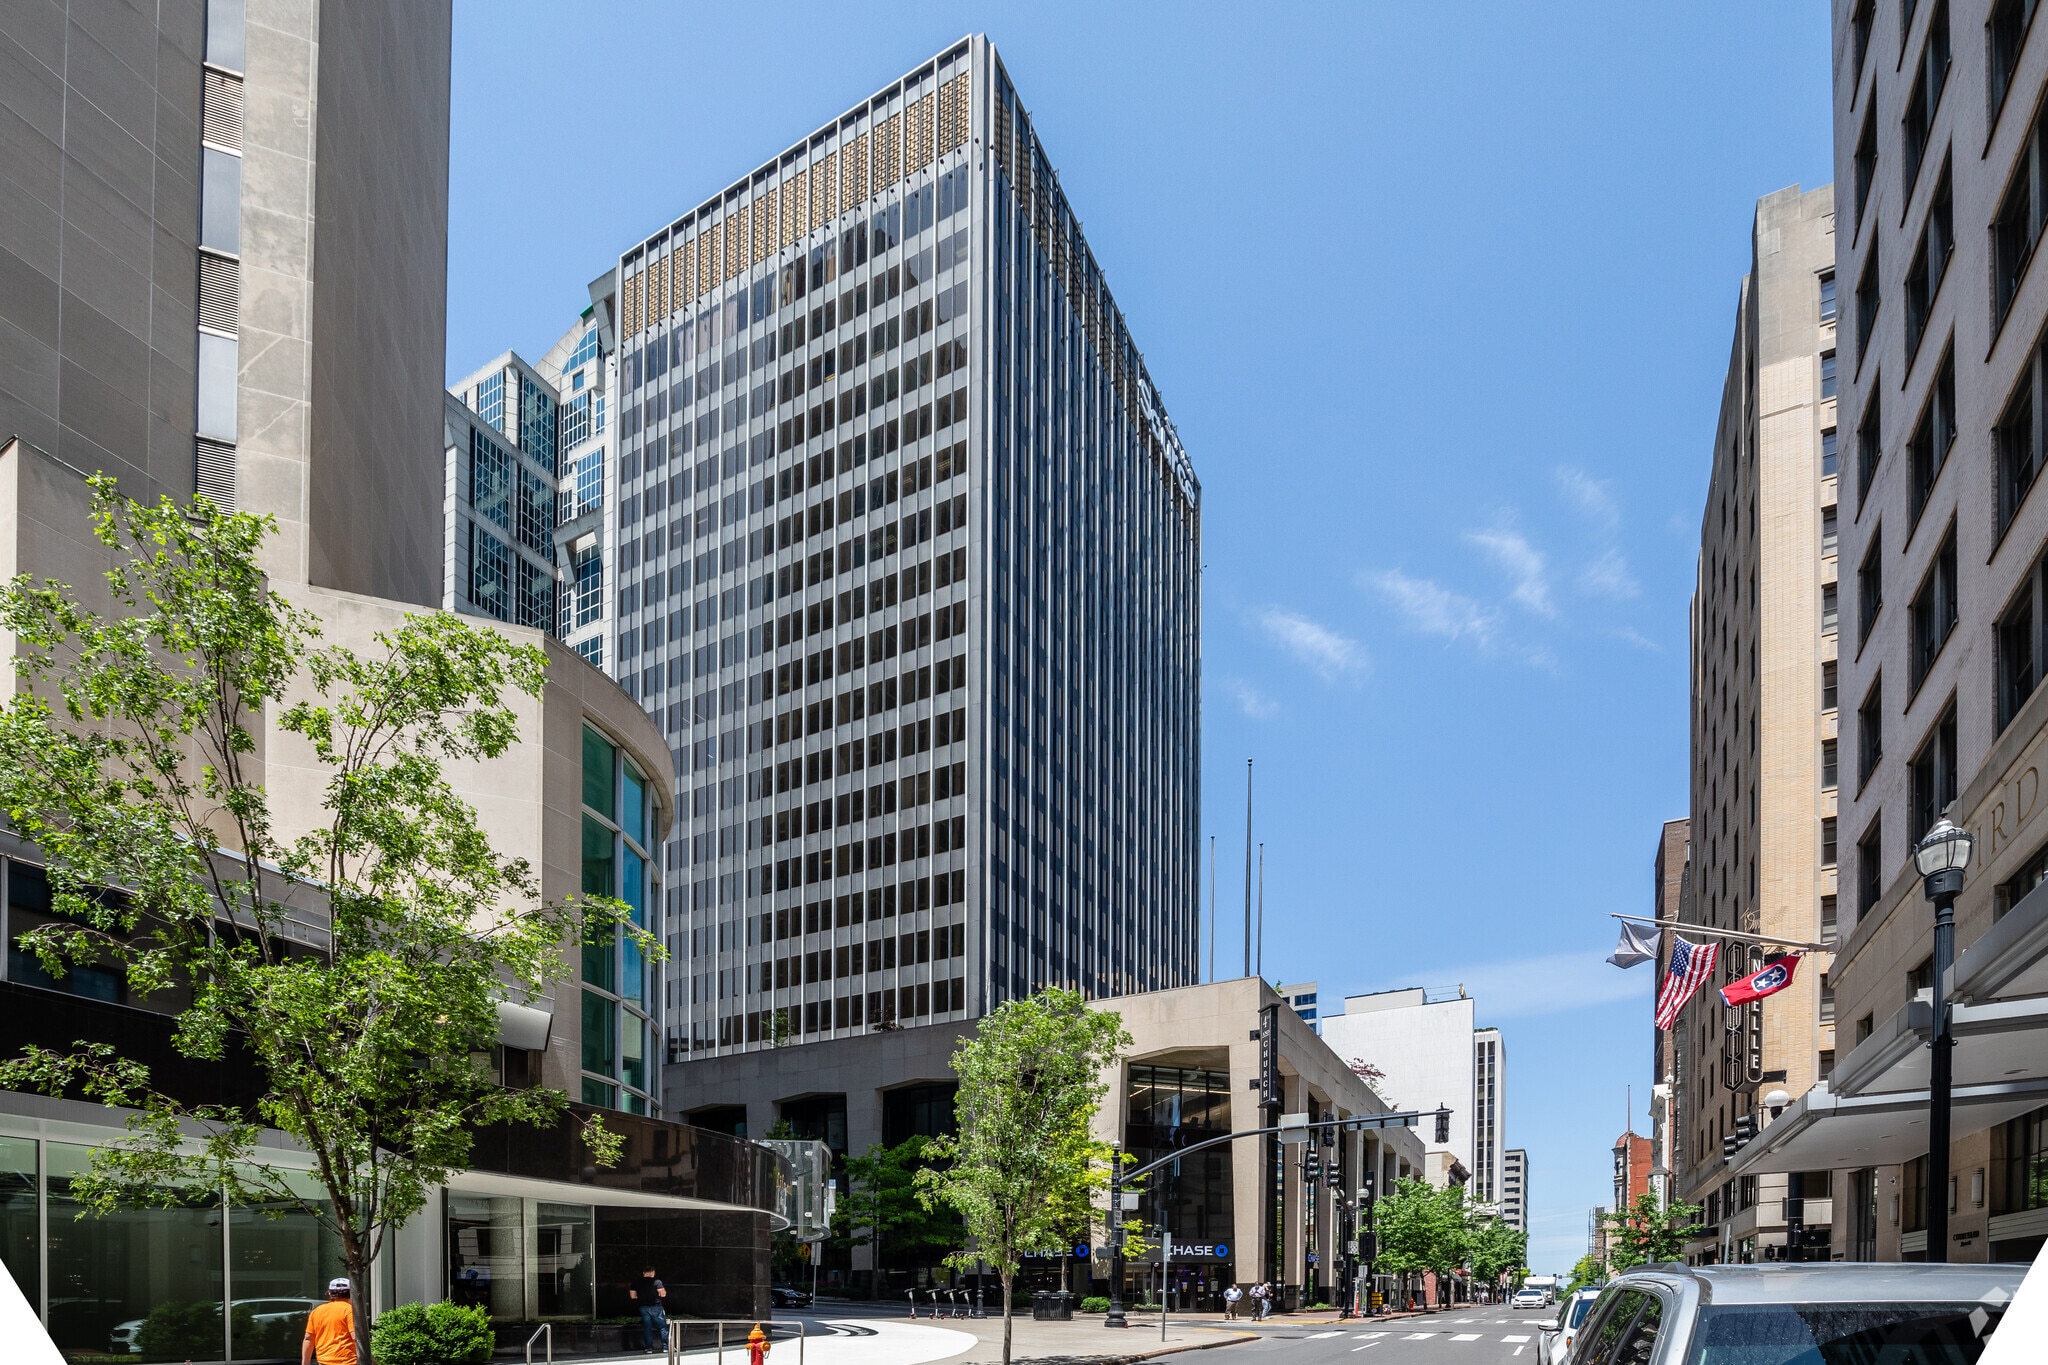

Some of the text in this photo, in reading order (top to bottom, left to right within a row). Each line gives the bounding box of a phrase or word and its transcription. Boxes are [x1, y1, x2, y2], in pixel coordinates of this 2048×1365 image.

[1138, 378, 1196, 508] Source
[1964, 766, 2039, 882] IRD
[1752, 958, 1761, 1069] NELLE
[1168, 1245, 1213, 1256] CHASE
